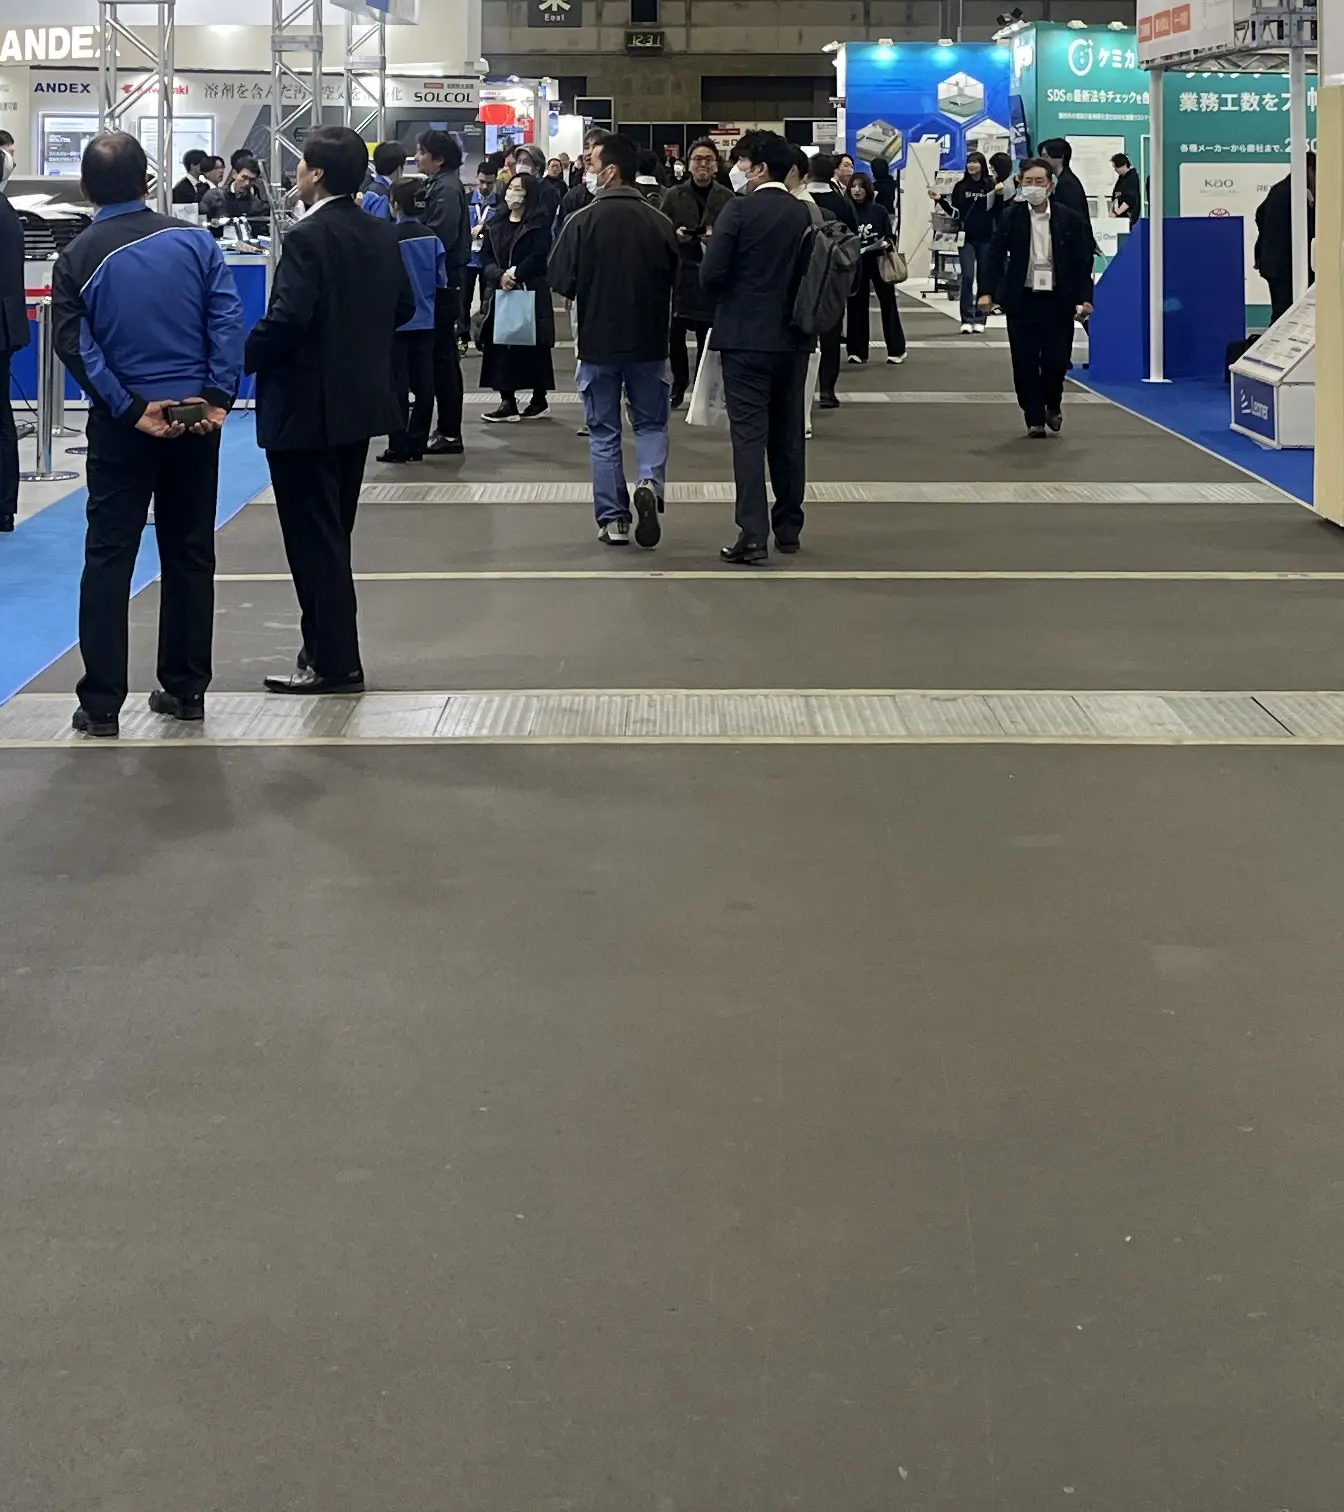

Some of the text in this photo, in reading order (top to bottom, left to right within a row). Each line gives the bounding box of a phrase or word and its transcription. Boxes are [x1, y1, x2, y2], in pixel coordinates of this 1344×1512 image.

[544, 14, 565, 22] East
[34, 83, 90, 93] ANDEX
[414, 92, 473, 103] SOLCOL
